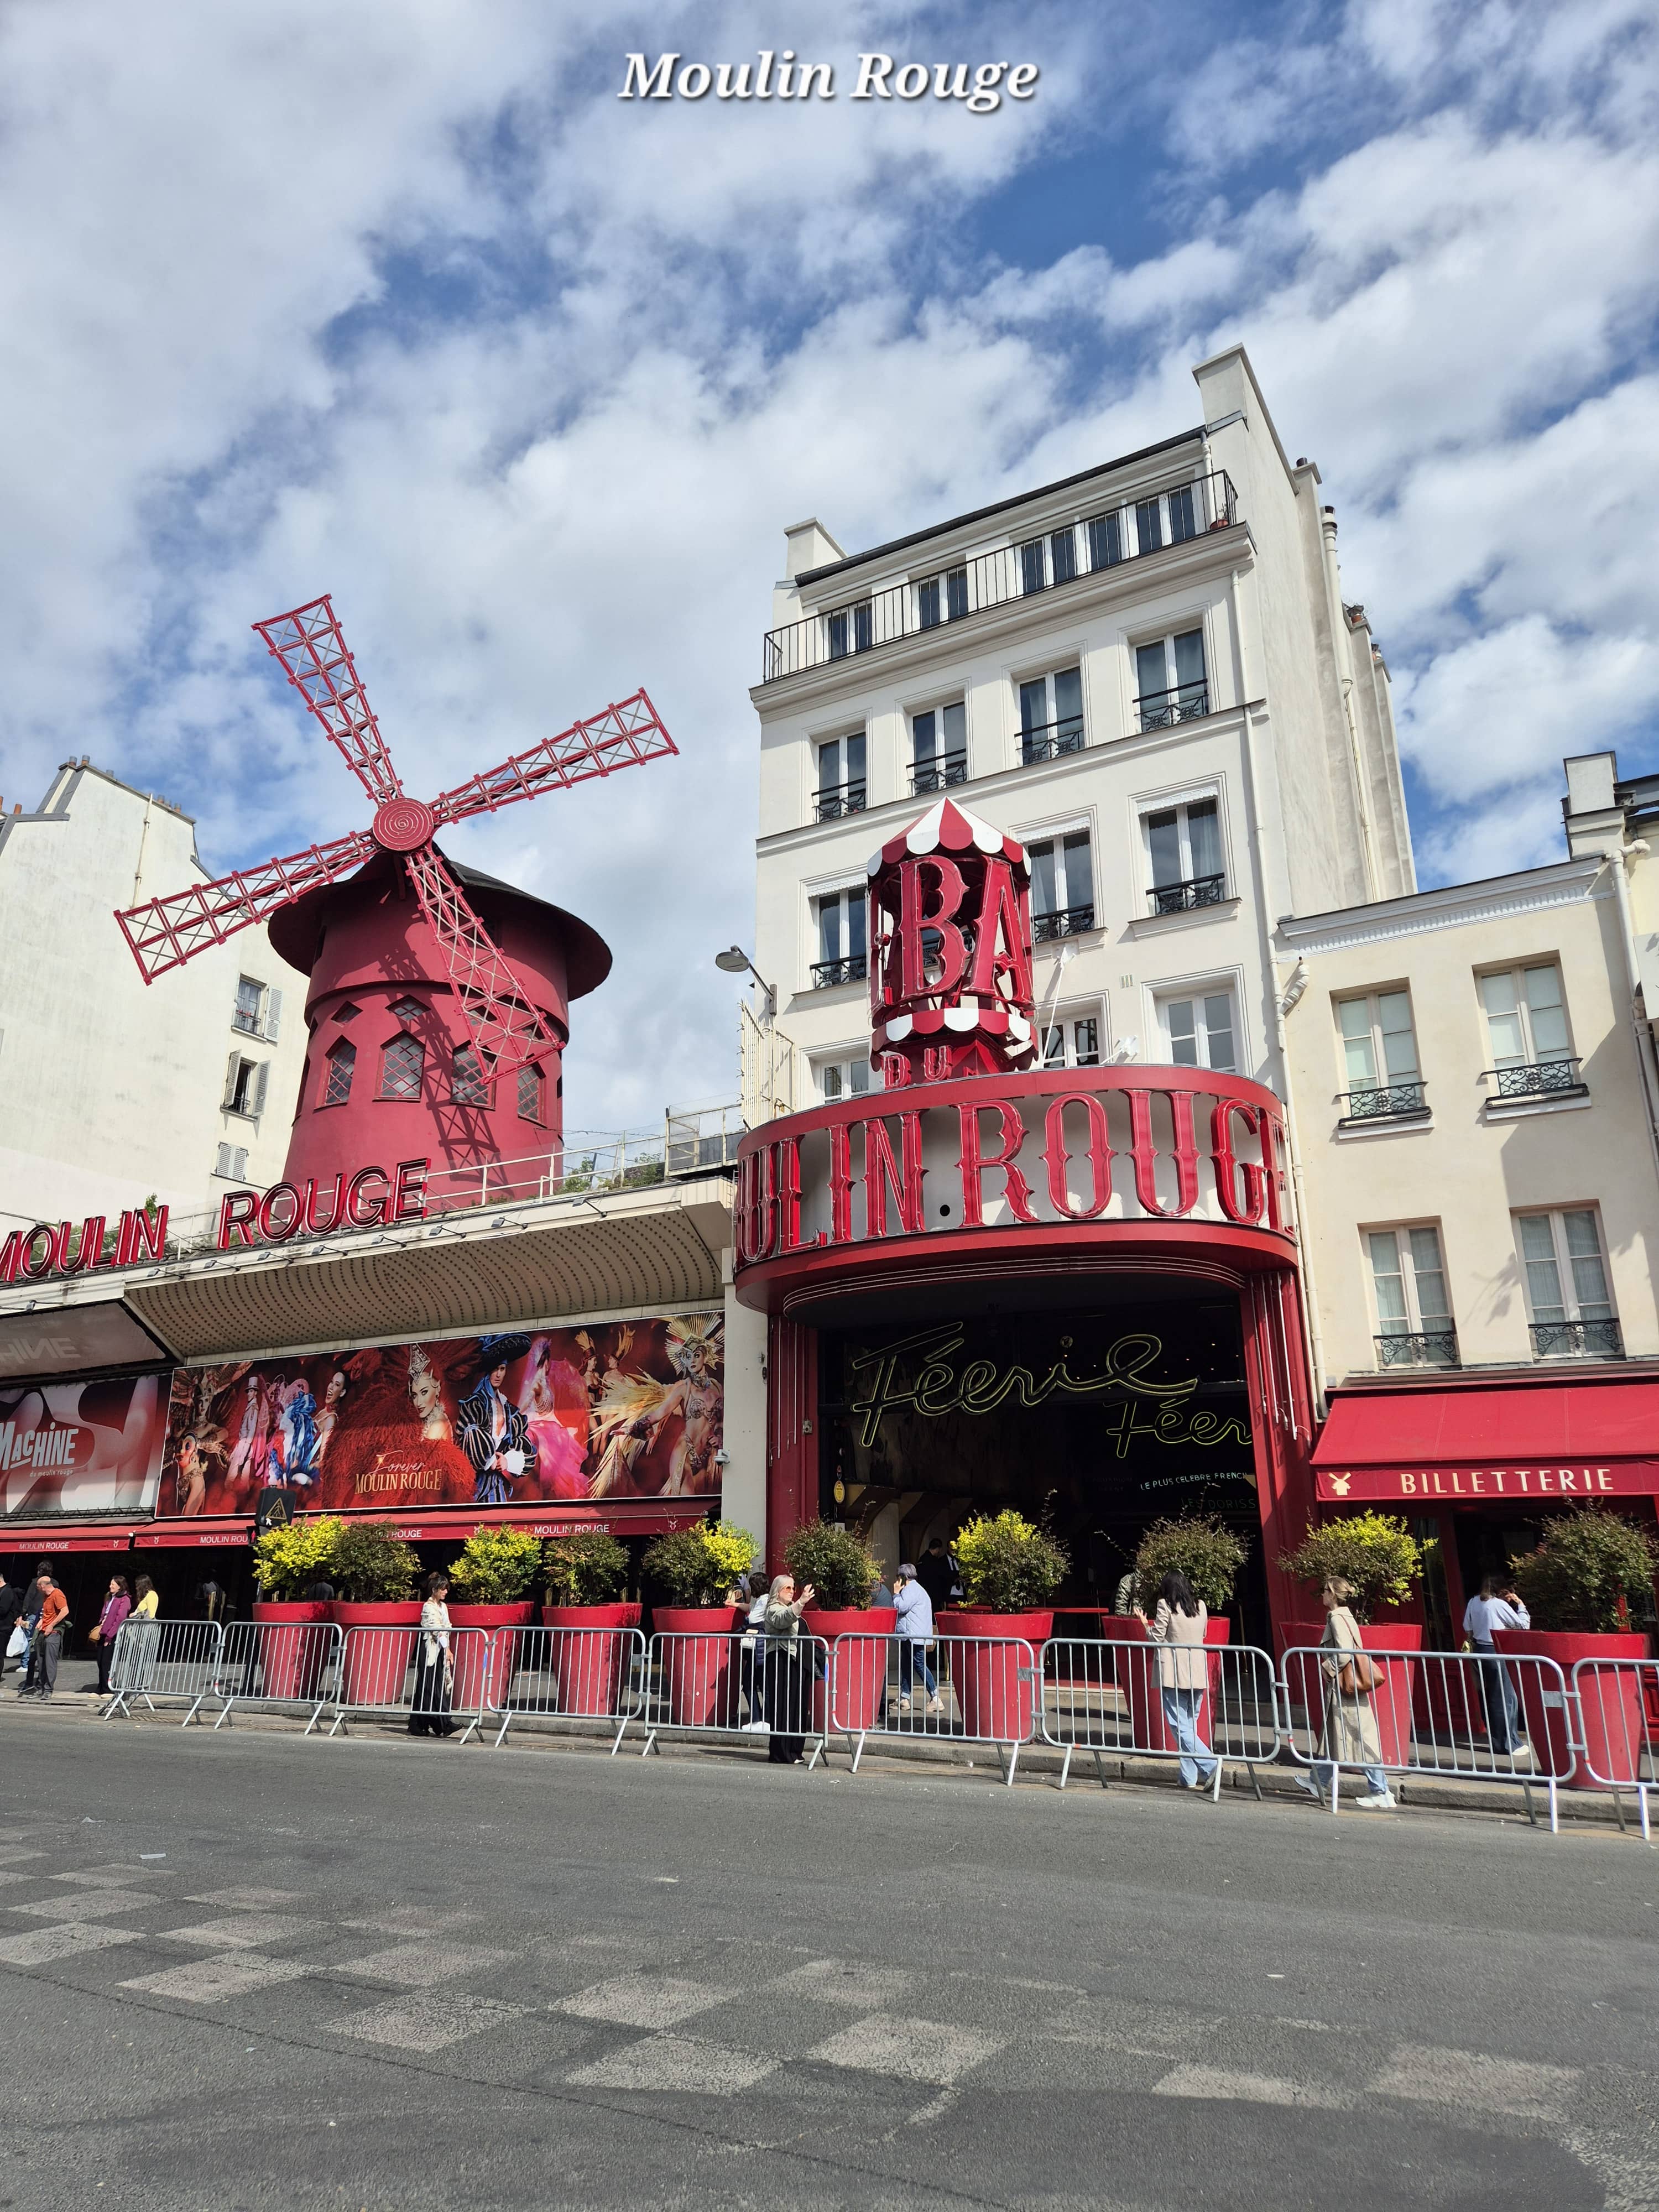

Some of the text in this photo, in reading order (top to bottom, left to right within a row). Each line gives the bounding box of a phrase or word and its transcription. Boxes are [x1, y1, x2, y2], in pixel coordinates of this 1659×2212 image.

[217, 1157, 431, 1250] ROUGE
[850, 1321, 1199, 1447] Féerie
[368, 1450, 426, 1474] Forever
[354, 1472, 399, 1494] MOULIN
[399, 1469, 442, 1490] ROUGE
[1140, 1481, 1150, 1490] LE
[1152, 1478, 1174, 1488] PLUS
[1400, 1468, 1614, 1494] BILLETTERIE
[200, 1535, 229, 1544] MOULIN
[575, 1524, 610, 1533] ROUGE
[19, 1541, 69, 1550] MOULIN ROUGE
